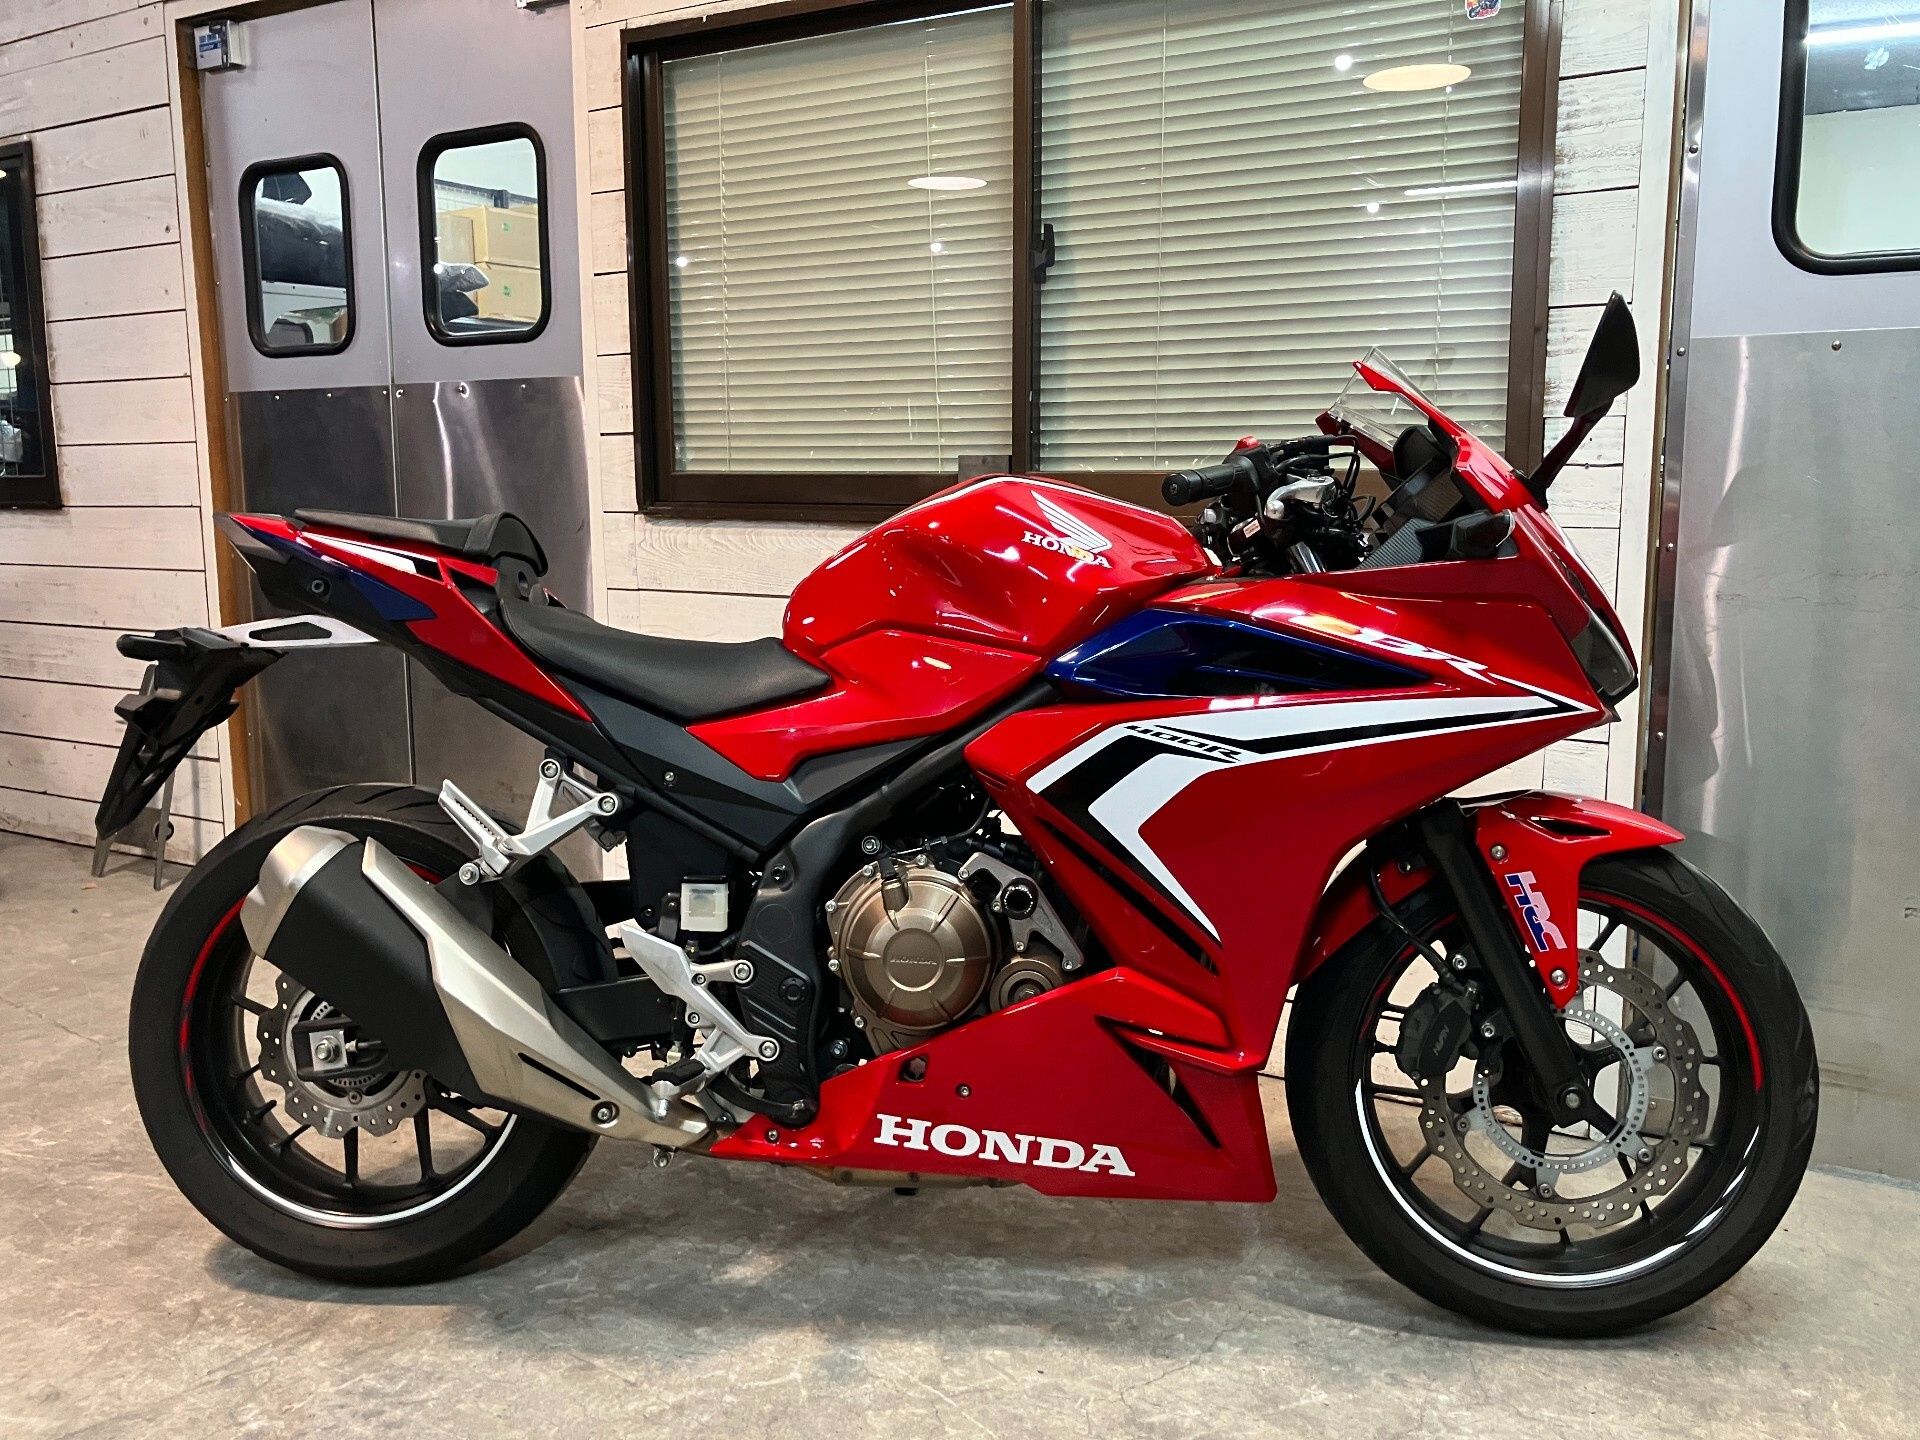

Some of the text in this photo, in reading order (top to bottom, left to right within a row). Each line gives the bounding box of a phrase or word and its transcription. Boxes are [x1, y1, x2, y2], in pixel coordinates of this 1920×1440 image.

[1021, 530, 1112, 569] HONDA
[1504, 870, 1568, 953] HRC
[873, 1113, 1136, 1177] HONDA
